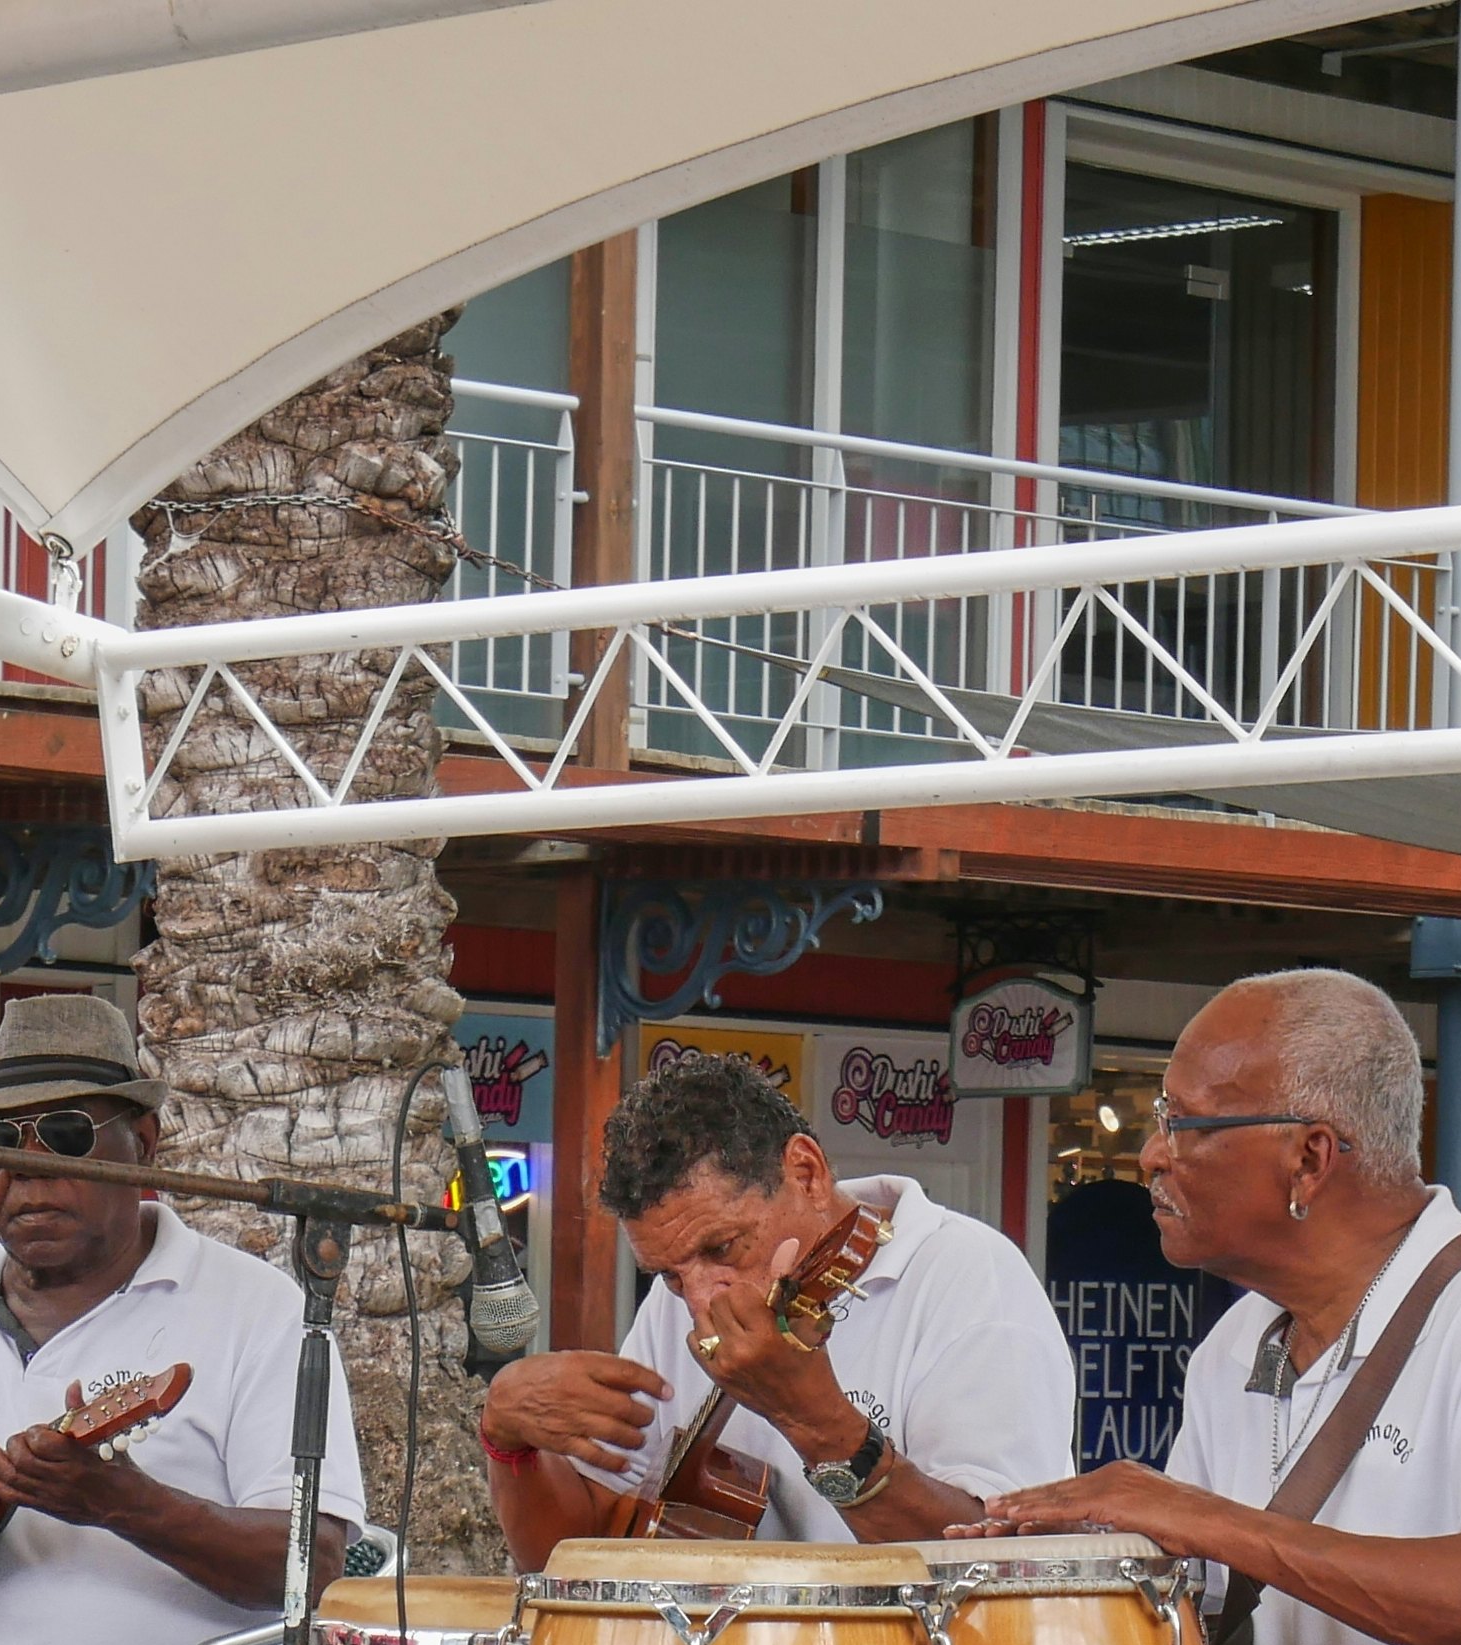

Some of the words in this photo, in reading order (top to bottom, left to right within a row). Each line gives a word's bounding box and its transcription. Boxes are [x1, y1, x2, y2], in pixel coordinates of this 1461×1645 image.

[992, 1006, 1044, 1039] Dushi
[995, 1031, 1056, 1066] Candy
[472, 1069, 523, 1127] ndy
[870, 1053, 940, 1101] Dushi
[875, 1089, 954, 1146] Candy
[1050, 1280, 1194, 1339] HEINEN
[1069, 1343, 1193, 1400] ELFTS
[289, 1473, 304, 1551] SAMSON
